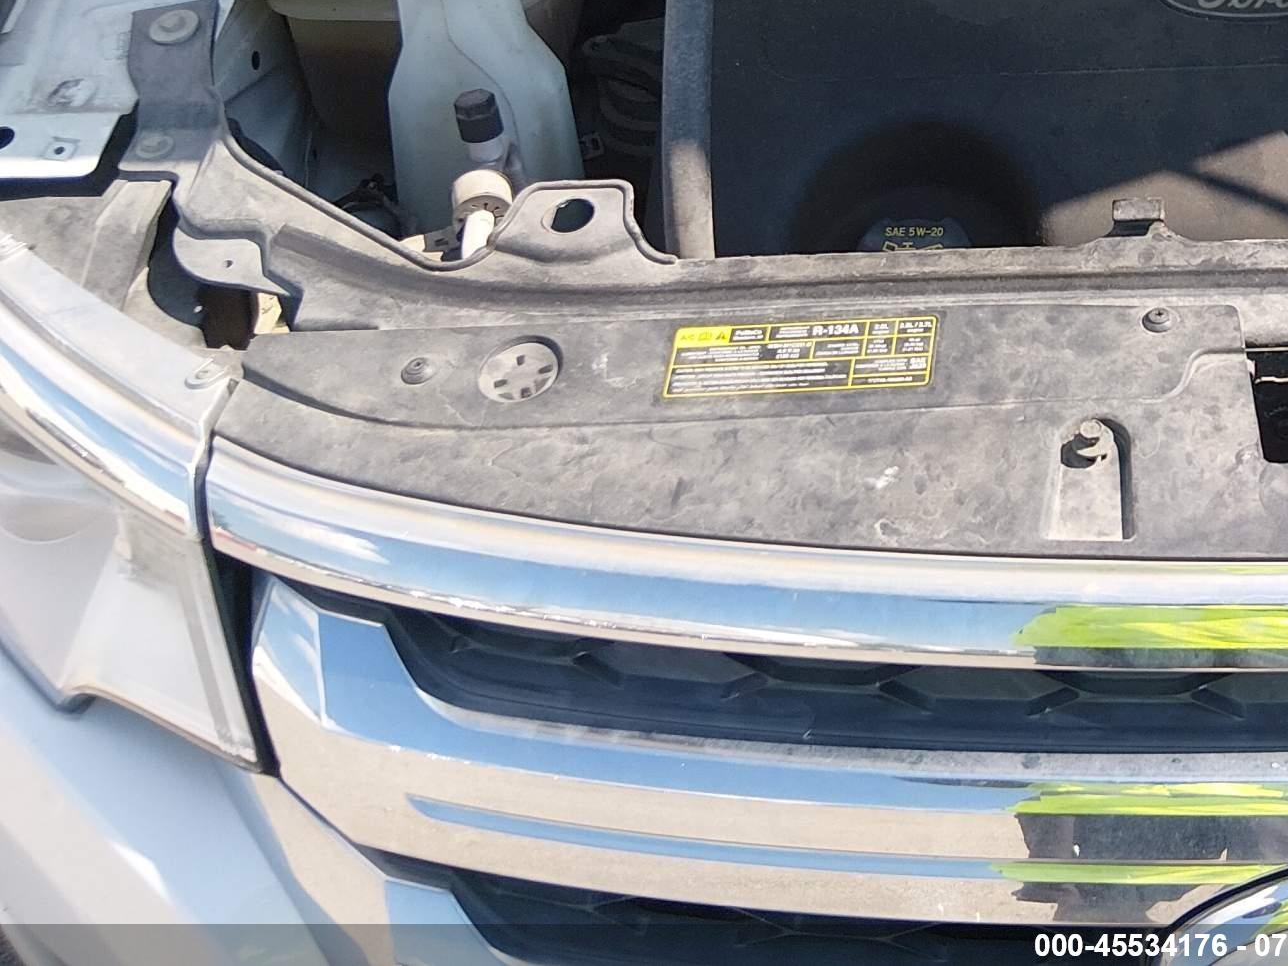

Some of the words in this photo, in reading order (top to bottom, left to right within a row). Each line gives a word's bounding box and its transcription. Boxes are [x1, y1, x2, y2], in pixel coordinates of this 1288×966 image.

[884, 227, 906, 237] SAE
[908, 227, 944, 237] 5W-20
[812, 323, 860, 336] R-134A
